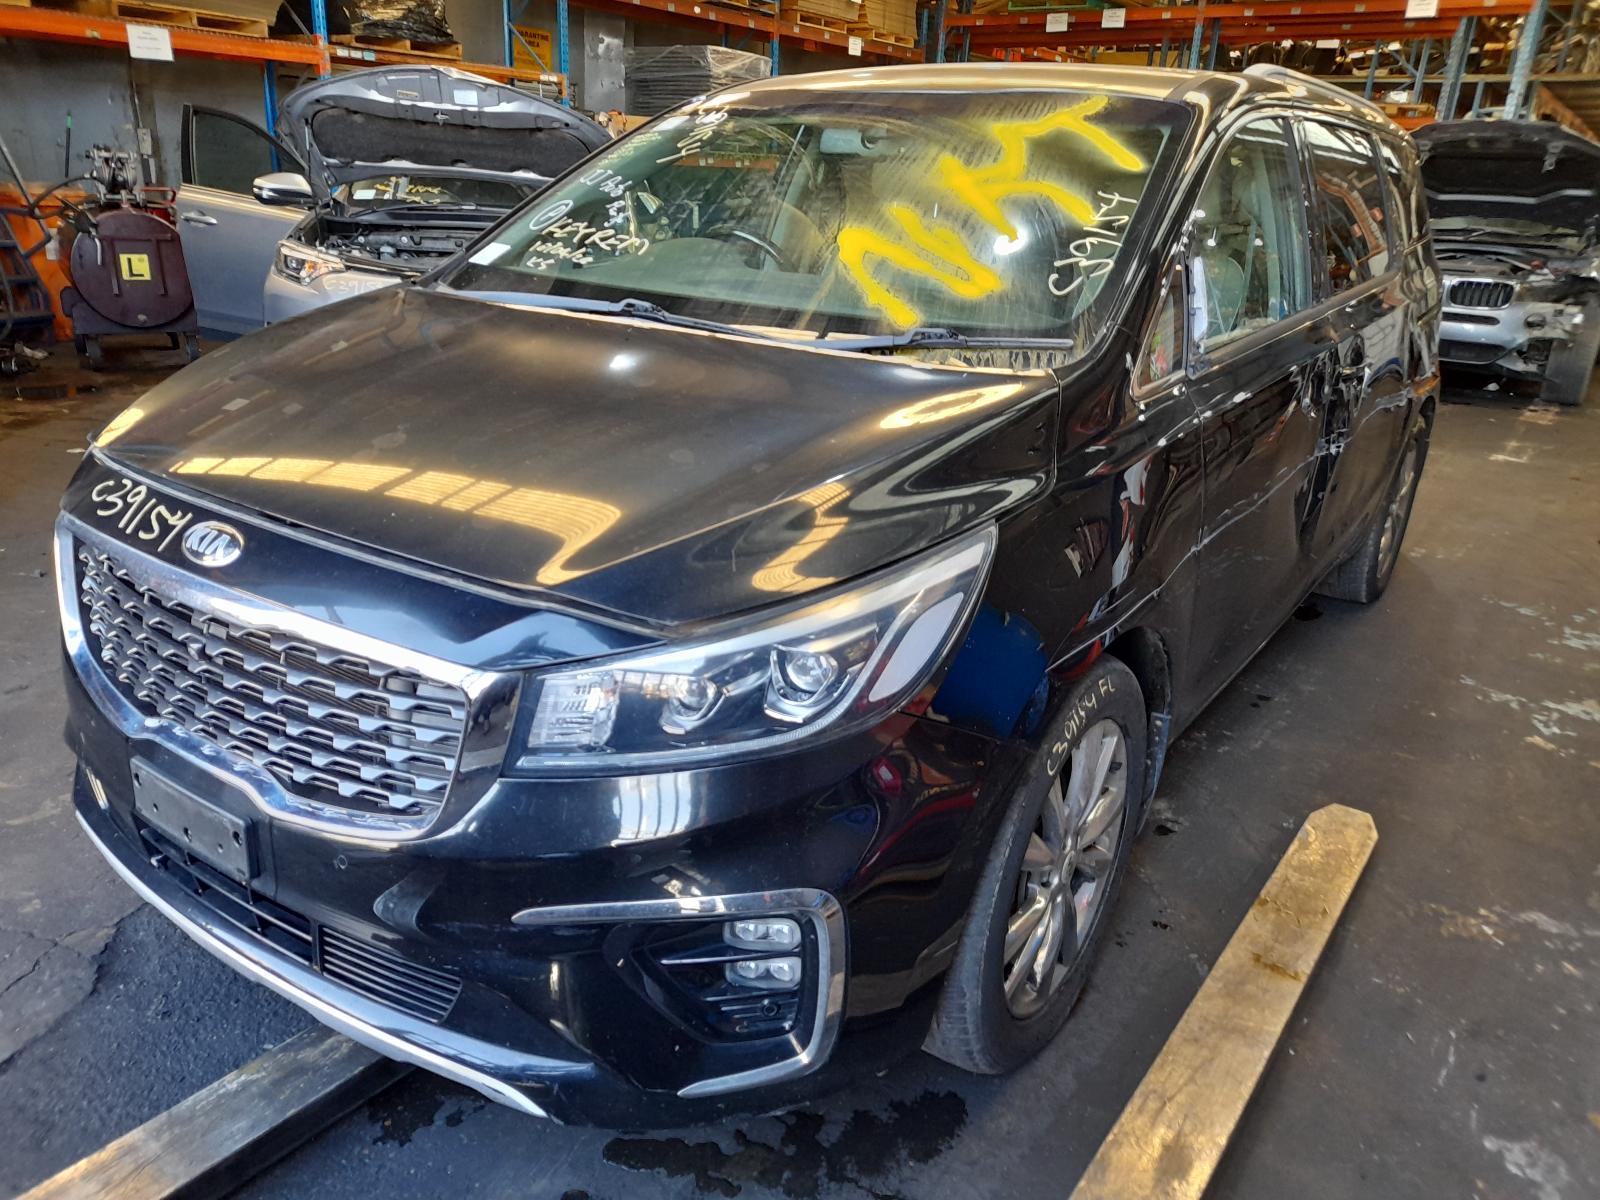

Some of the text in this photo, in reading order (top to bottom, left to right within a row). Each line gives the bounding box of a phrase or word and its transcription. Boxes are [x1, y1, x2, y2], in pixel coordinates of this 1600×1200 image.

[127, 257, 145, 278] L
[91, 478, 194, 552] C39154
[185, 526, 233, 561] KIA
